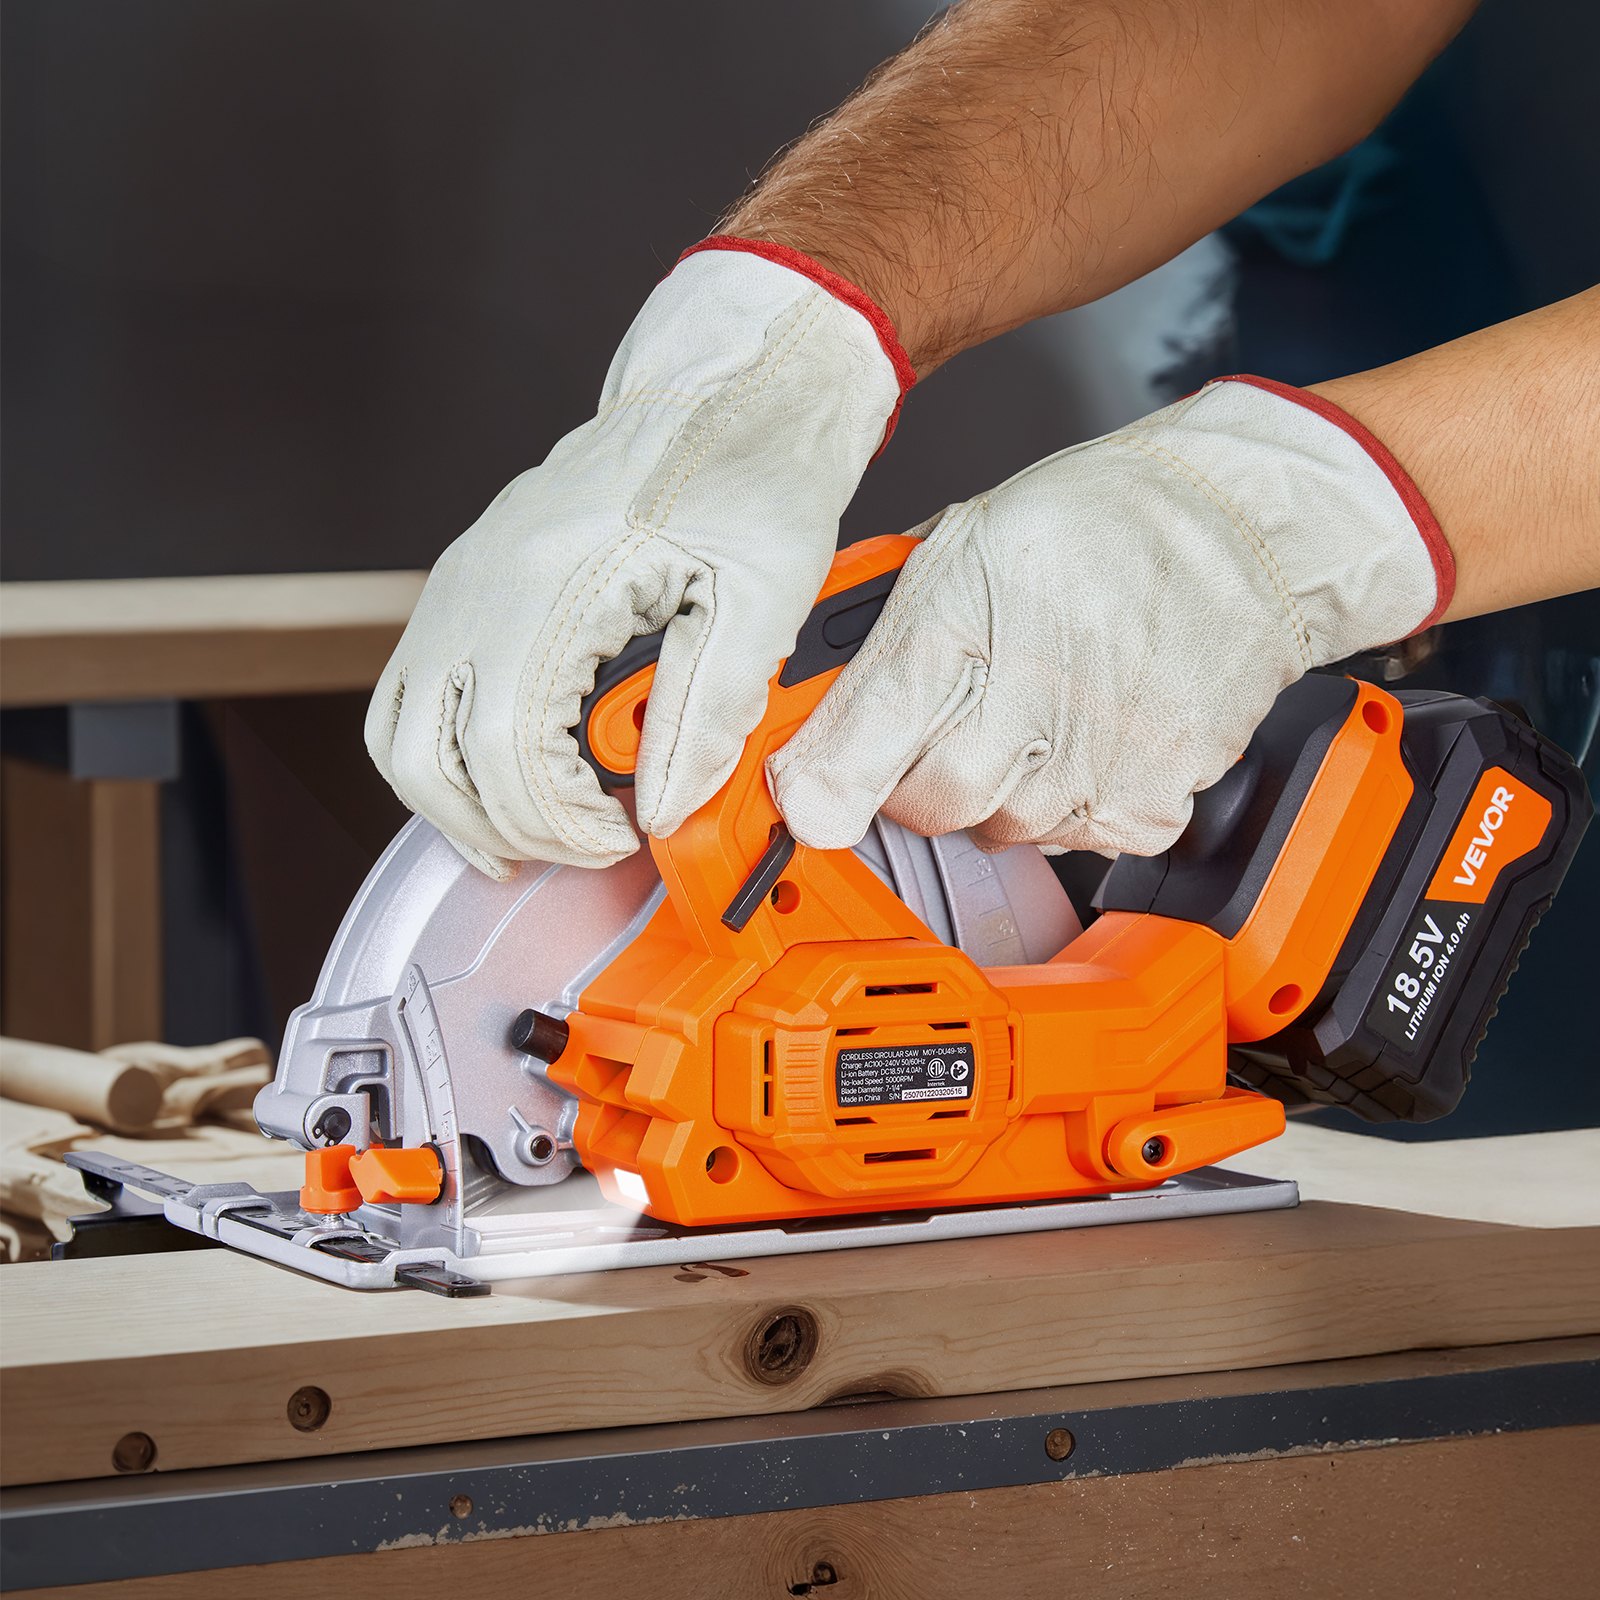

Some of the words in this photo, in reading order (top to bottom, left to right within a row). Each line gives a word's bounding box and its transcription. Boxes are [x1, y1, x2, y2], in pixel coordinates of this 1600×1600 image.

[1453, 786, 1515, 887] VEVOR
[1386, 913, 1445, 1016] 18.5V
[1404, 984, 1438, 1041] LITHIUM
[1433, 954, 1451, 984] ION
[1445, 932, 1461, 957] 4.0
[1457, 911, 1471, 934] Ah
[841, 1052, 873, 1061] CORDLESS
[874, 1050, 904, 1059] CIRCULAR
[904, 1049, 919, 1057] SAW
[864, 1059, 901, 1068] AC100-240V
[901, 1058, 926, 1066] 50/60Hz
[841, 1070, 857, 1079] Li-ion
[880, 1067, 905, 1076] DC18.5V
[905, 1066, 923, 1074] 4.0Ah
[841, 1078, 864, 1086] No-load
[885, 1075, 914, 1084] 5000RPM
[841, 1087, 857, 1095] Blade
[903, 1087, 963, 1099] 250701220320516
[840, 1095, 858, 1103] Made
[864, 1094, 881, 1102] China
